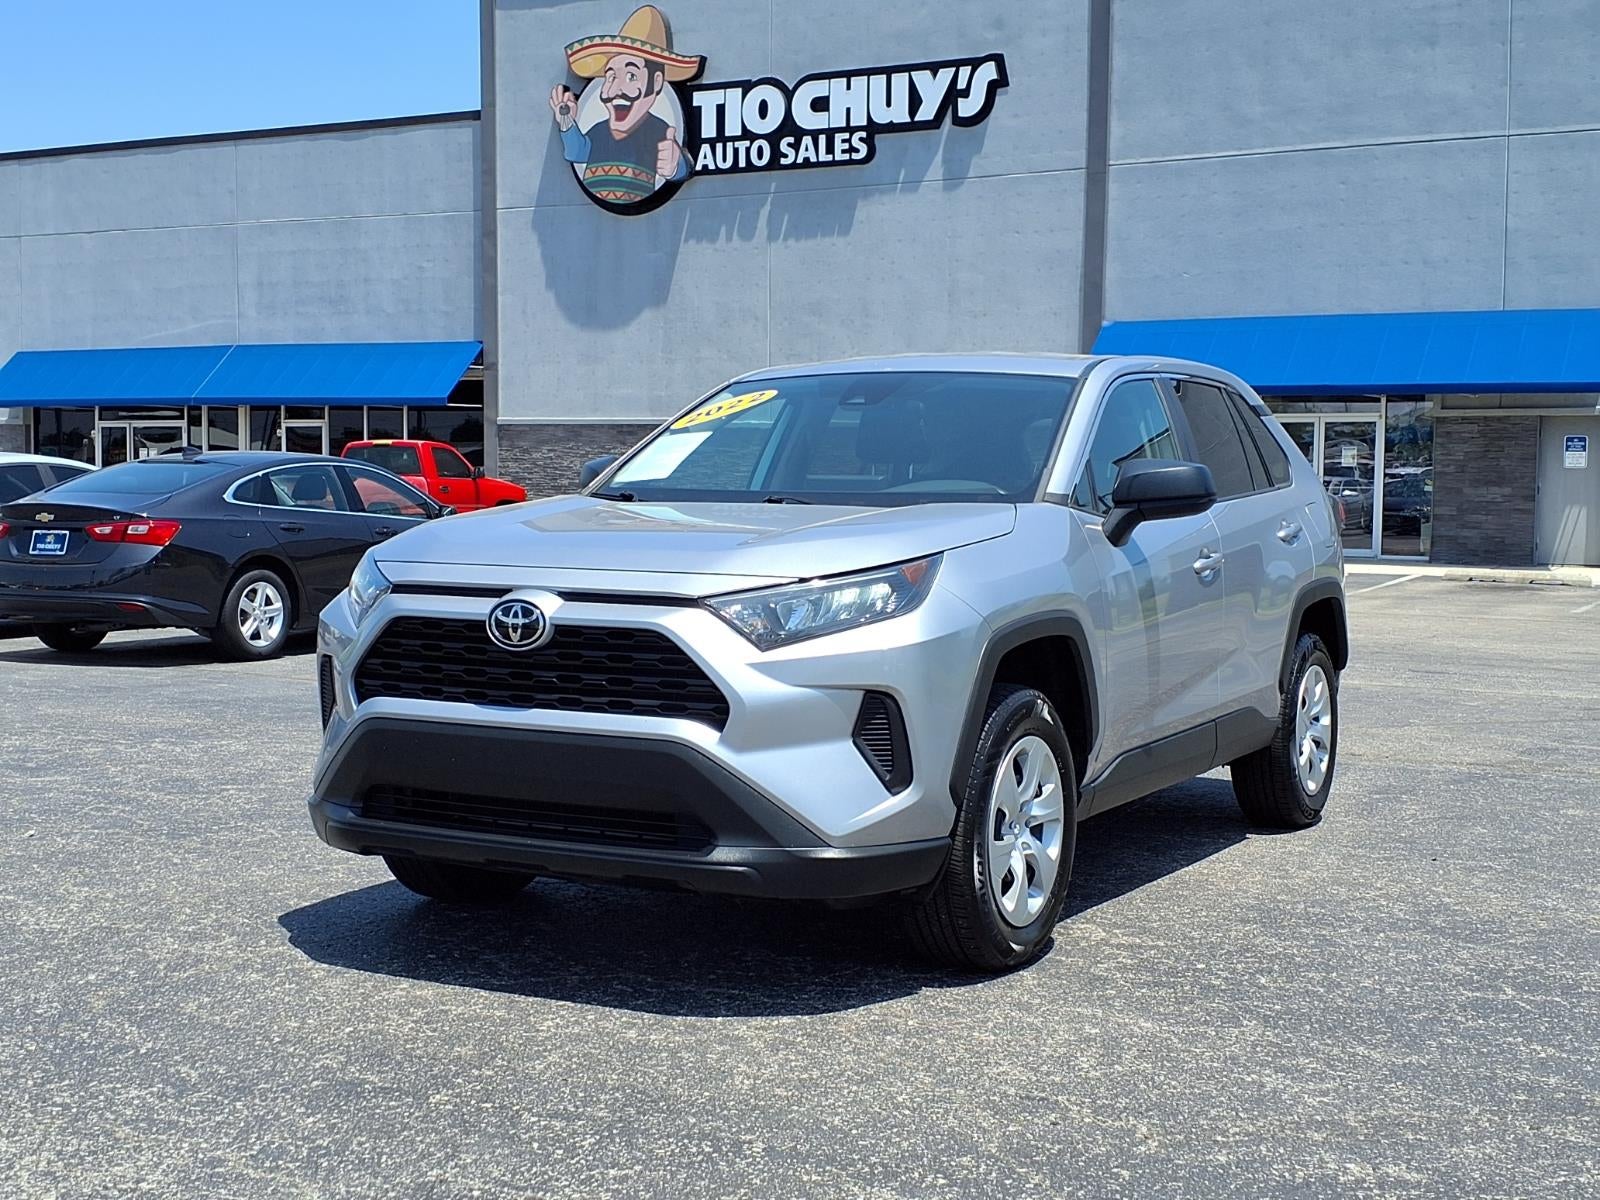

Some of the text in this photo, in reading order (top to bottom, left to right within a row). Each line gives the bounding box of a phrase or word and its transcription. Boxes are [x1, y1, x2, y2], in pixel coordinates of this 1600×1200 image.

[693, 61, 998, 138] TIO CHUY'S
[695, 131, 868, 171] AUTO SALES
[684, 392, 766, 424] 2022
